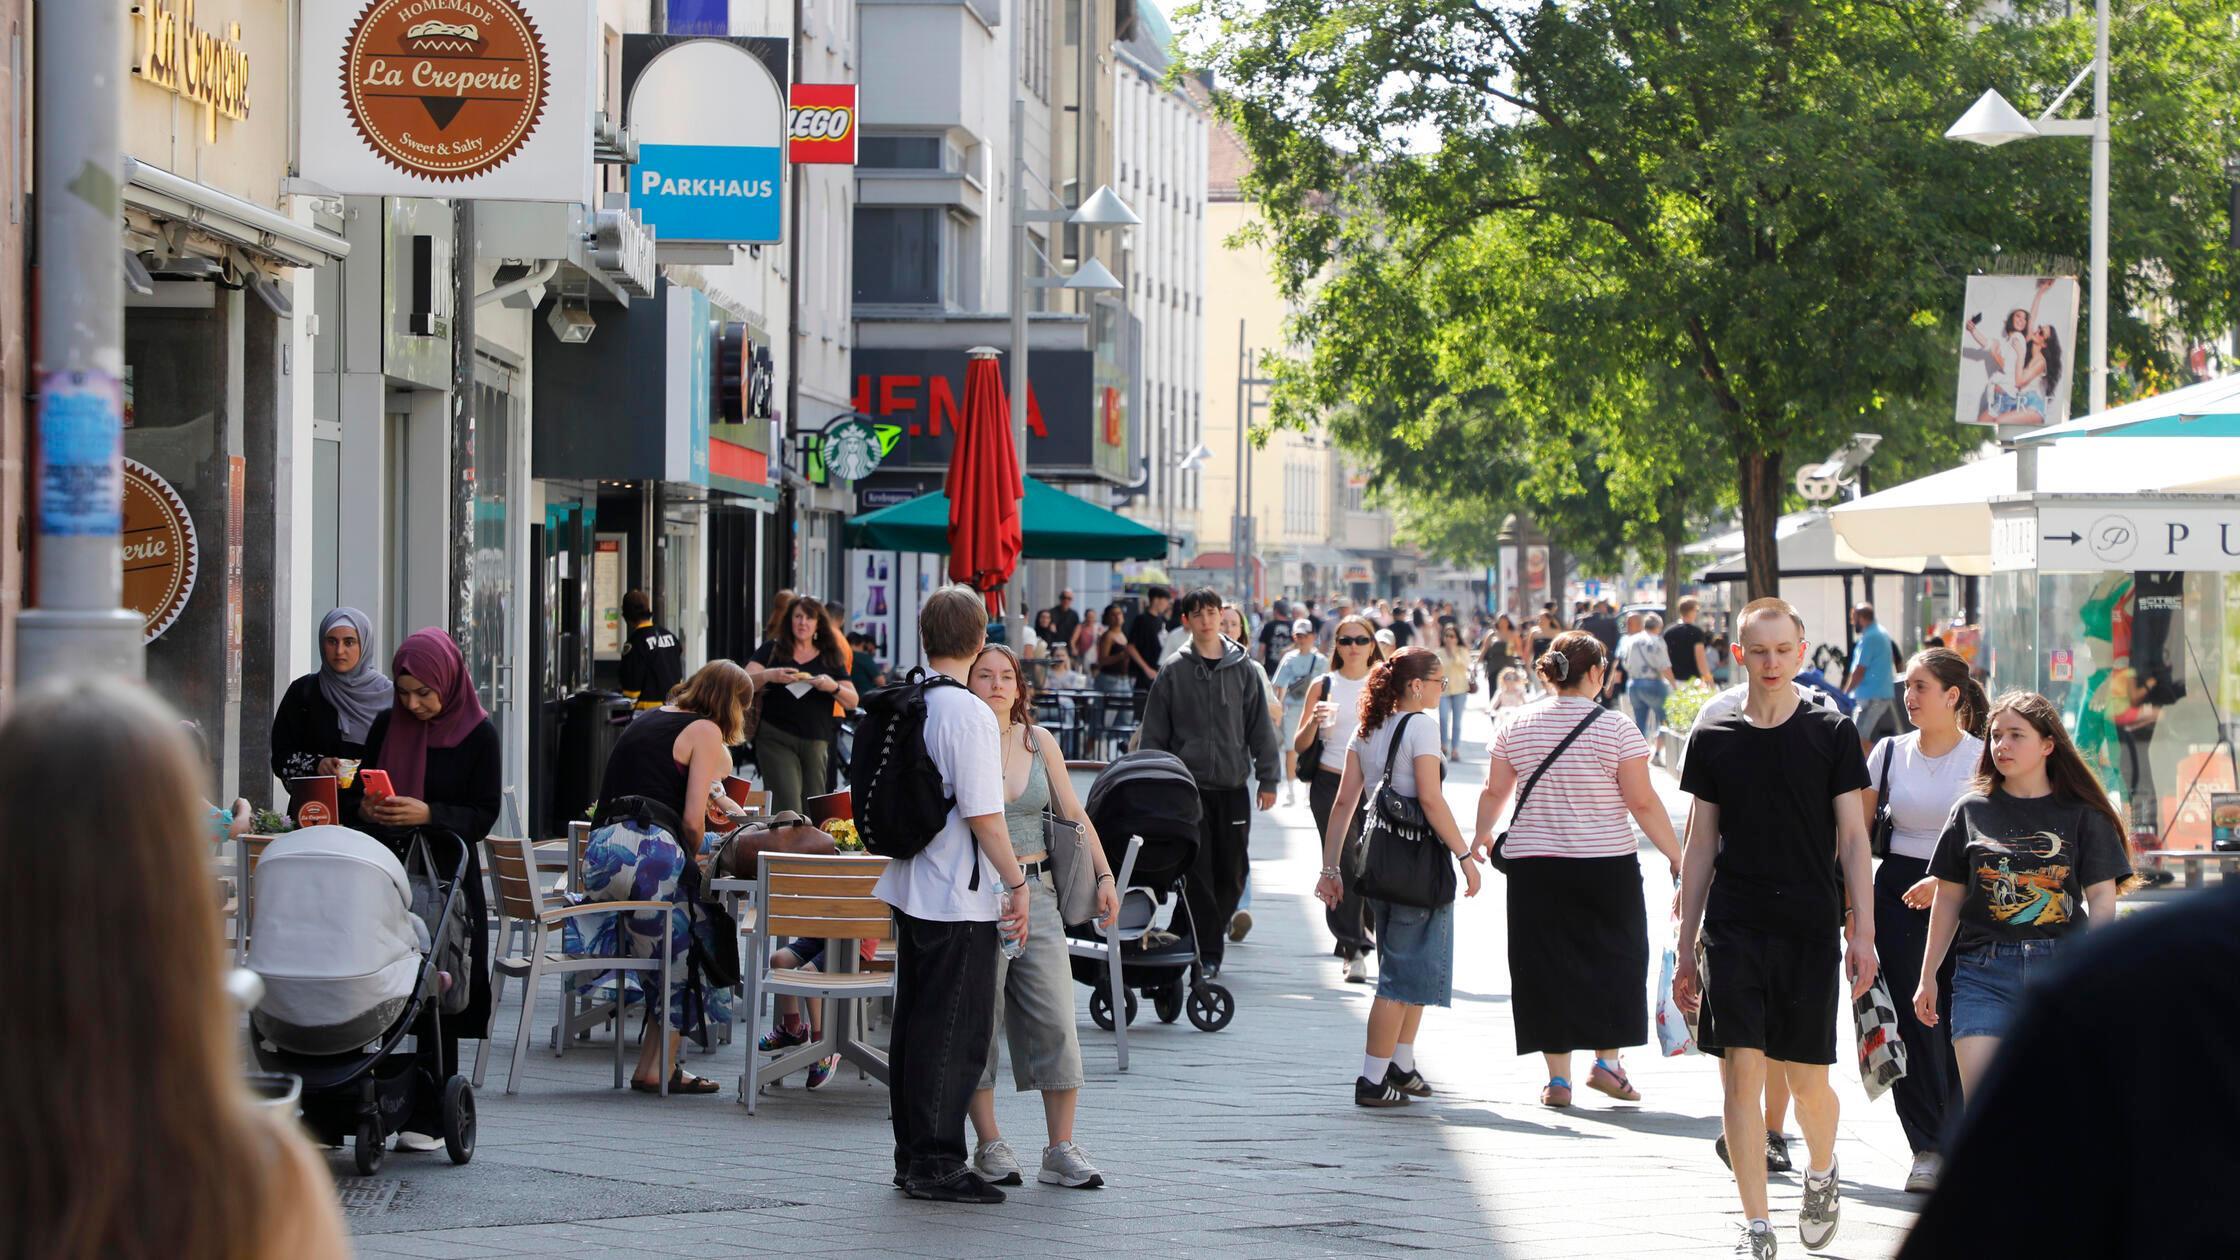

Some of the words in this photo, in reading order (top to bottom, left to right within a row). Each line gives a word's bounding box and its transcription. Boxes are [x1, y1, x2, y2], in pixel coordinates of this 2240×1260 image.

[398, 0, 494, 25] HOMEMADE
[364, 60, 403, 86] La
[412, 60, 523, 96] Creperie
[789, 108, 850, 139] LEGO
[399, 132, 435, 154] Sweet
[436, 142, 450, 155] &
[452, 136, 484, 155] Salty
